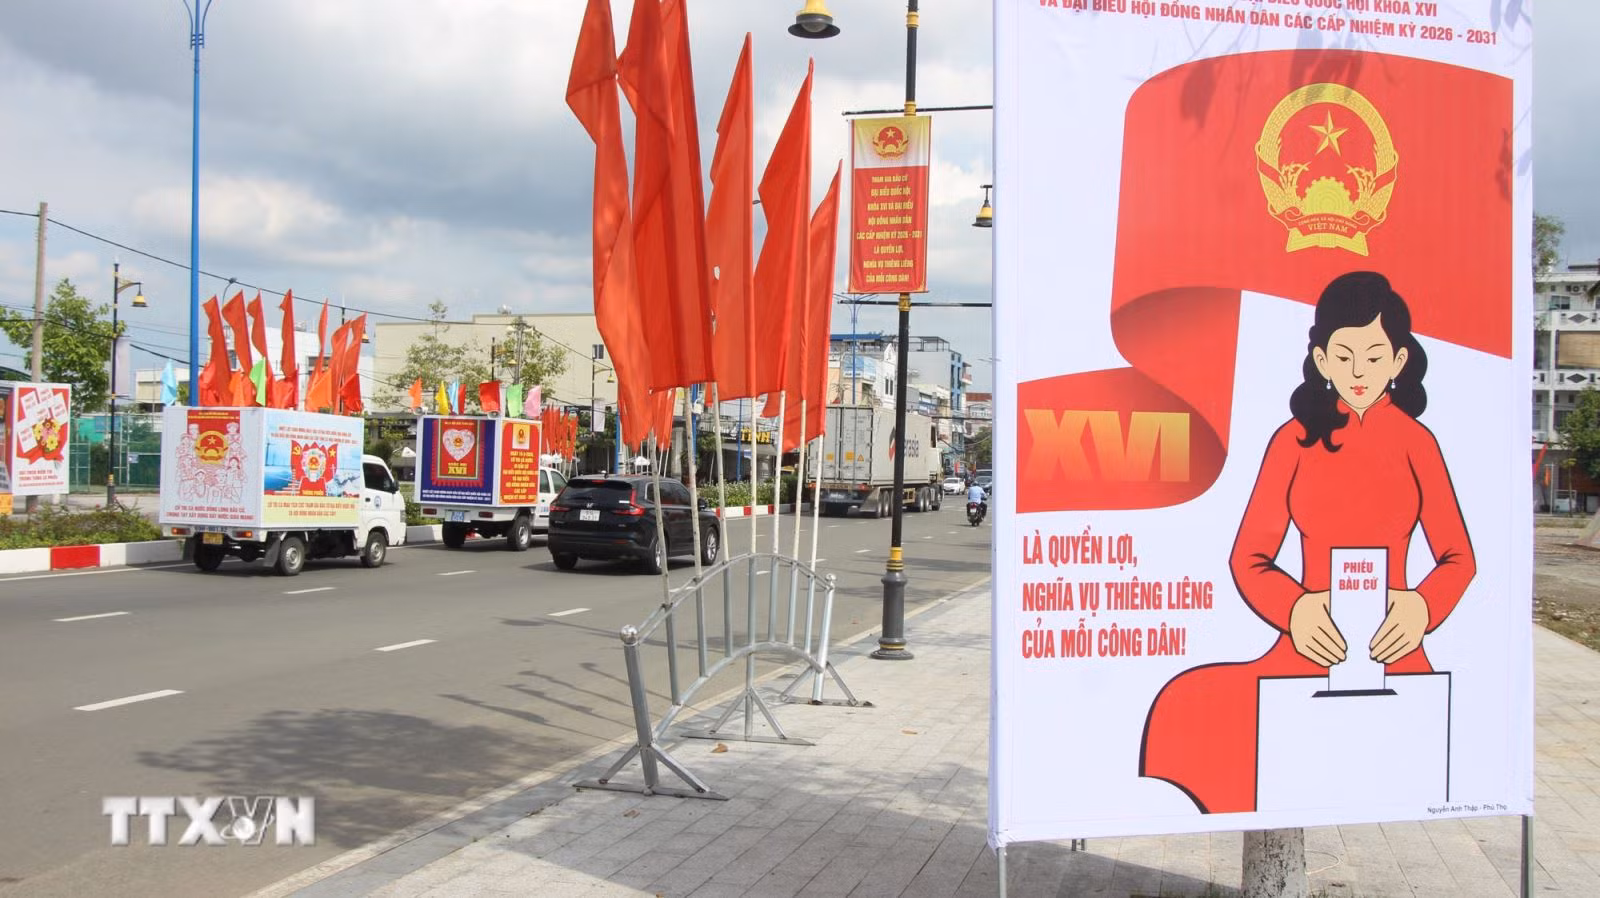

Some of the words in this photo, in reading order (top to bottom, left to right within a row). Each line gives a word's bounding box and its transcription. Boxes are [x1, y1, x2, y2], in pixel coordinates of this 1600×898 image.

[1131, 0, 1155, 18] HỘI
[1160, 0, 1200, 20] ĐỒNG
[1205, 6, 1245, 24] NHÂN
[1250, 9, 1279, 27] DÂN
[1284, 12, 1312, 29] CÁC
[1317, 13, 1345, 31] CẤP
[1350, 19, 1395, 38] NHIỆM
[1398, 21, 1416, 38] KỲ
[1420, 26, 1453, 41] 2026
[1466, 29, 1497, 45] 2031
[1415, 2, 1437, 17] XVI
[1329, 223, 1348, 233] NAM
[1024, 409, 1190, 482] XVI
[1023, 530, 1043, 564] LÀ
[1048, 525, 1102, 567] QUYỀN
[1108, 533, 1138, 571] LỢI,
[1343, 557, 1374, 573] PHIẾU
[1022, 577, 1074, 611] NGHĨA
[1079, 582, 1100, 617] VỤ
[1105, 576, 1163, 610] THIÊNG
[1167, 576, 1213, 610] LIÊNG
[1339, 576, 1360, 591] BẦU
[1363, 576, 1379, 591] CỬ
[1022, 617, 1055, 659] CỦA
[1061, 618, 1092, 657] MỖI
[1098, 623, 1142, 657] CÔNG
[1147, 622, 1186, 656] DÂN!
